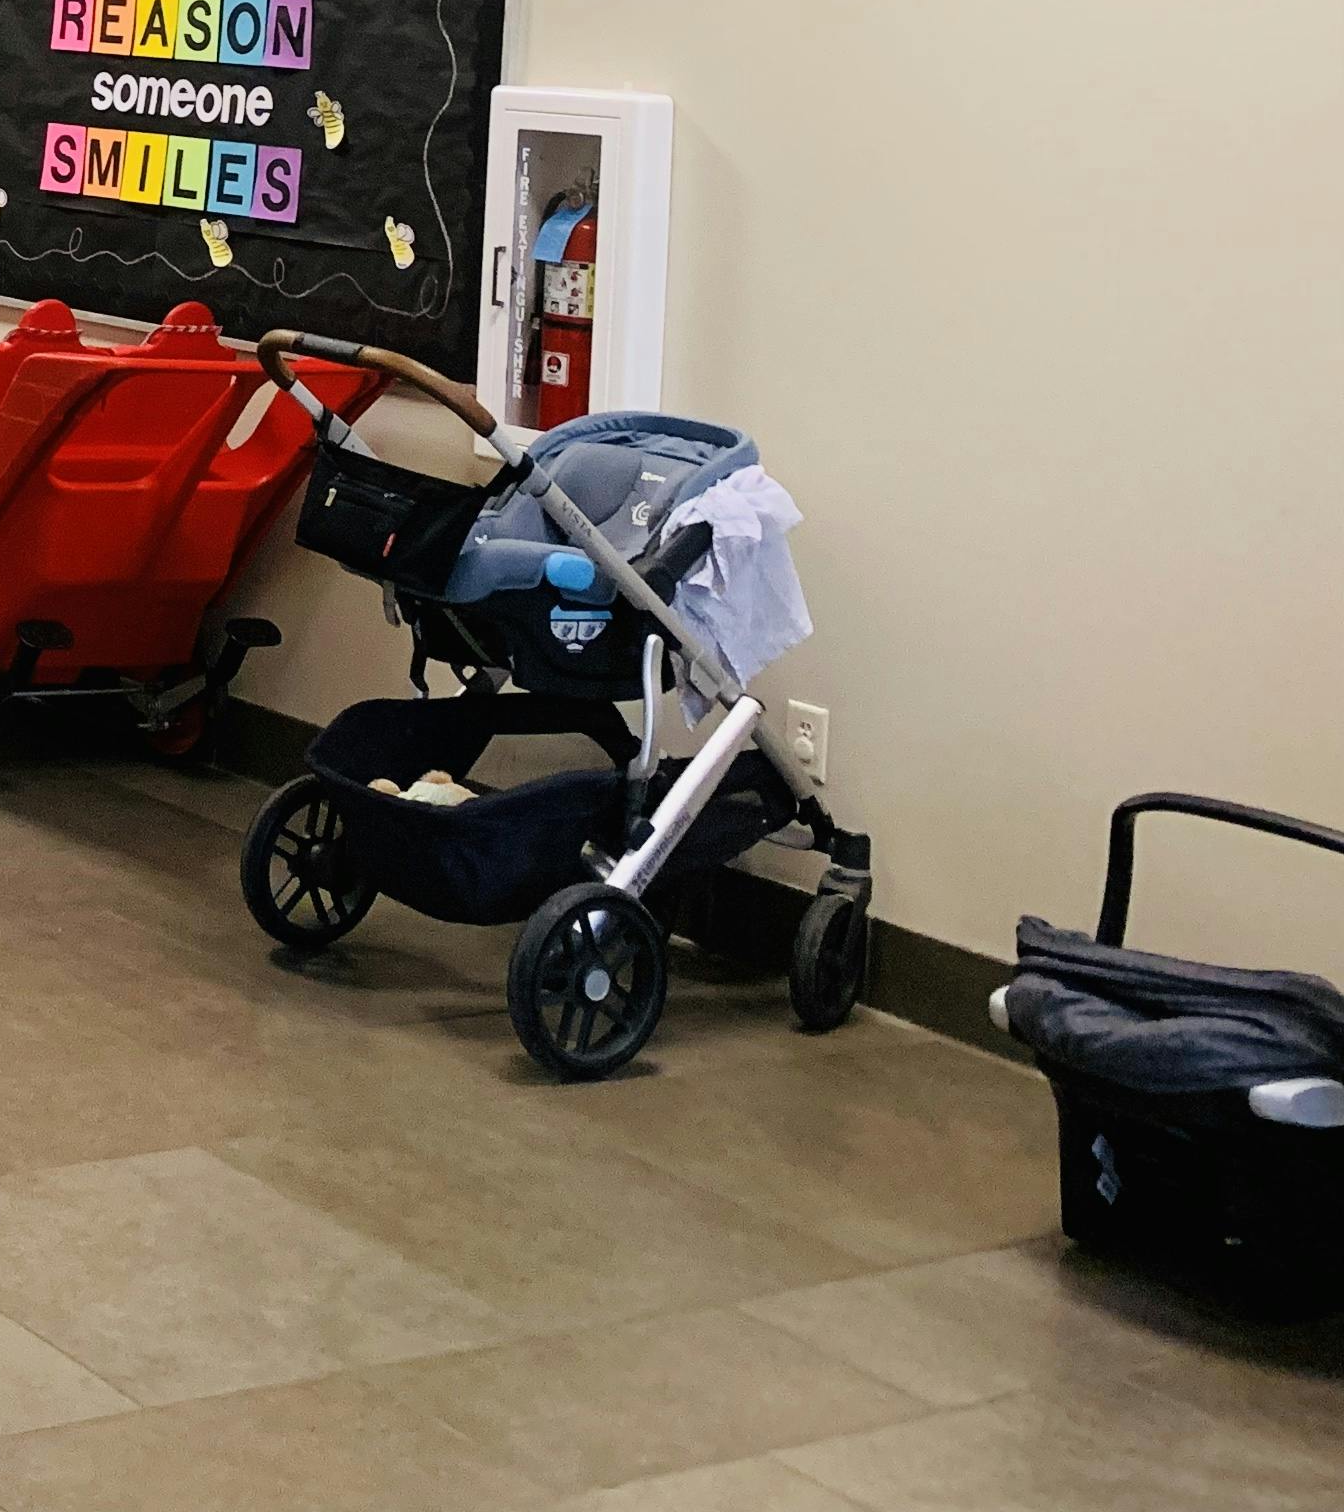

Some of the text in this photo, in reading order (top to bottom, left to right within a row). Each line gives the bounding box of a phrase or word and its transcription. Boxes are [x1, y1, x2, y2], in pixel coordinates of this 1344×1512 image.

[91, 71, 274, 127] someone
[47, 131, 296, 216] SMILES
[511, 146, 532, 399] FIRE EXTINGUISHER
[561, 501, 593, 537] VISTA
